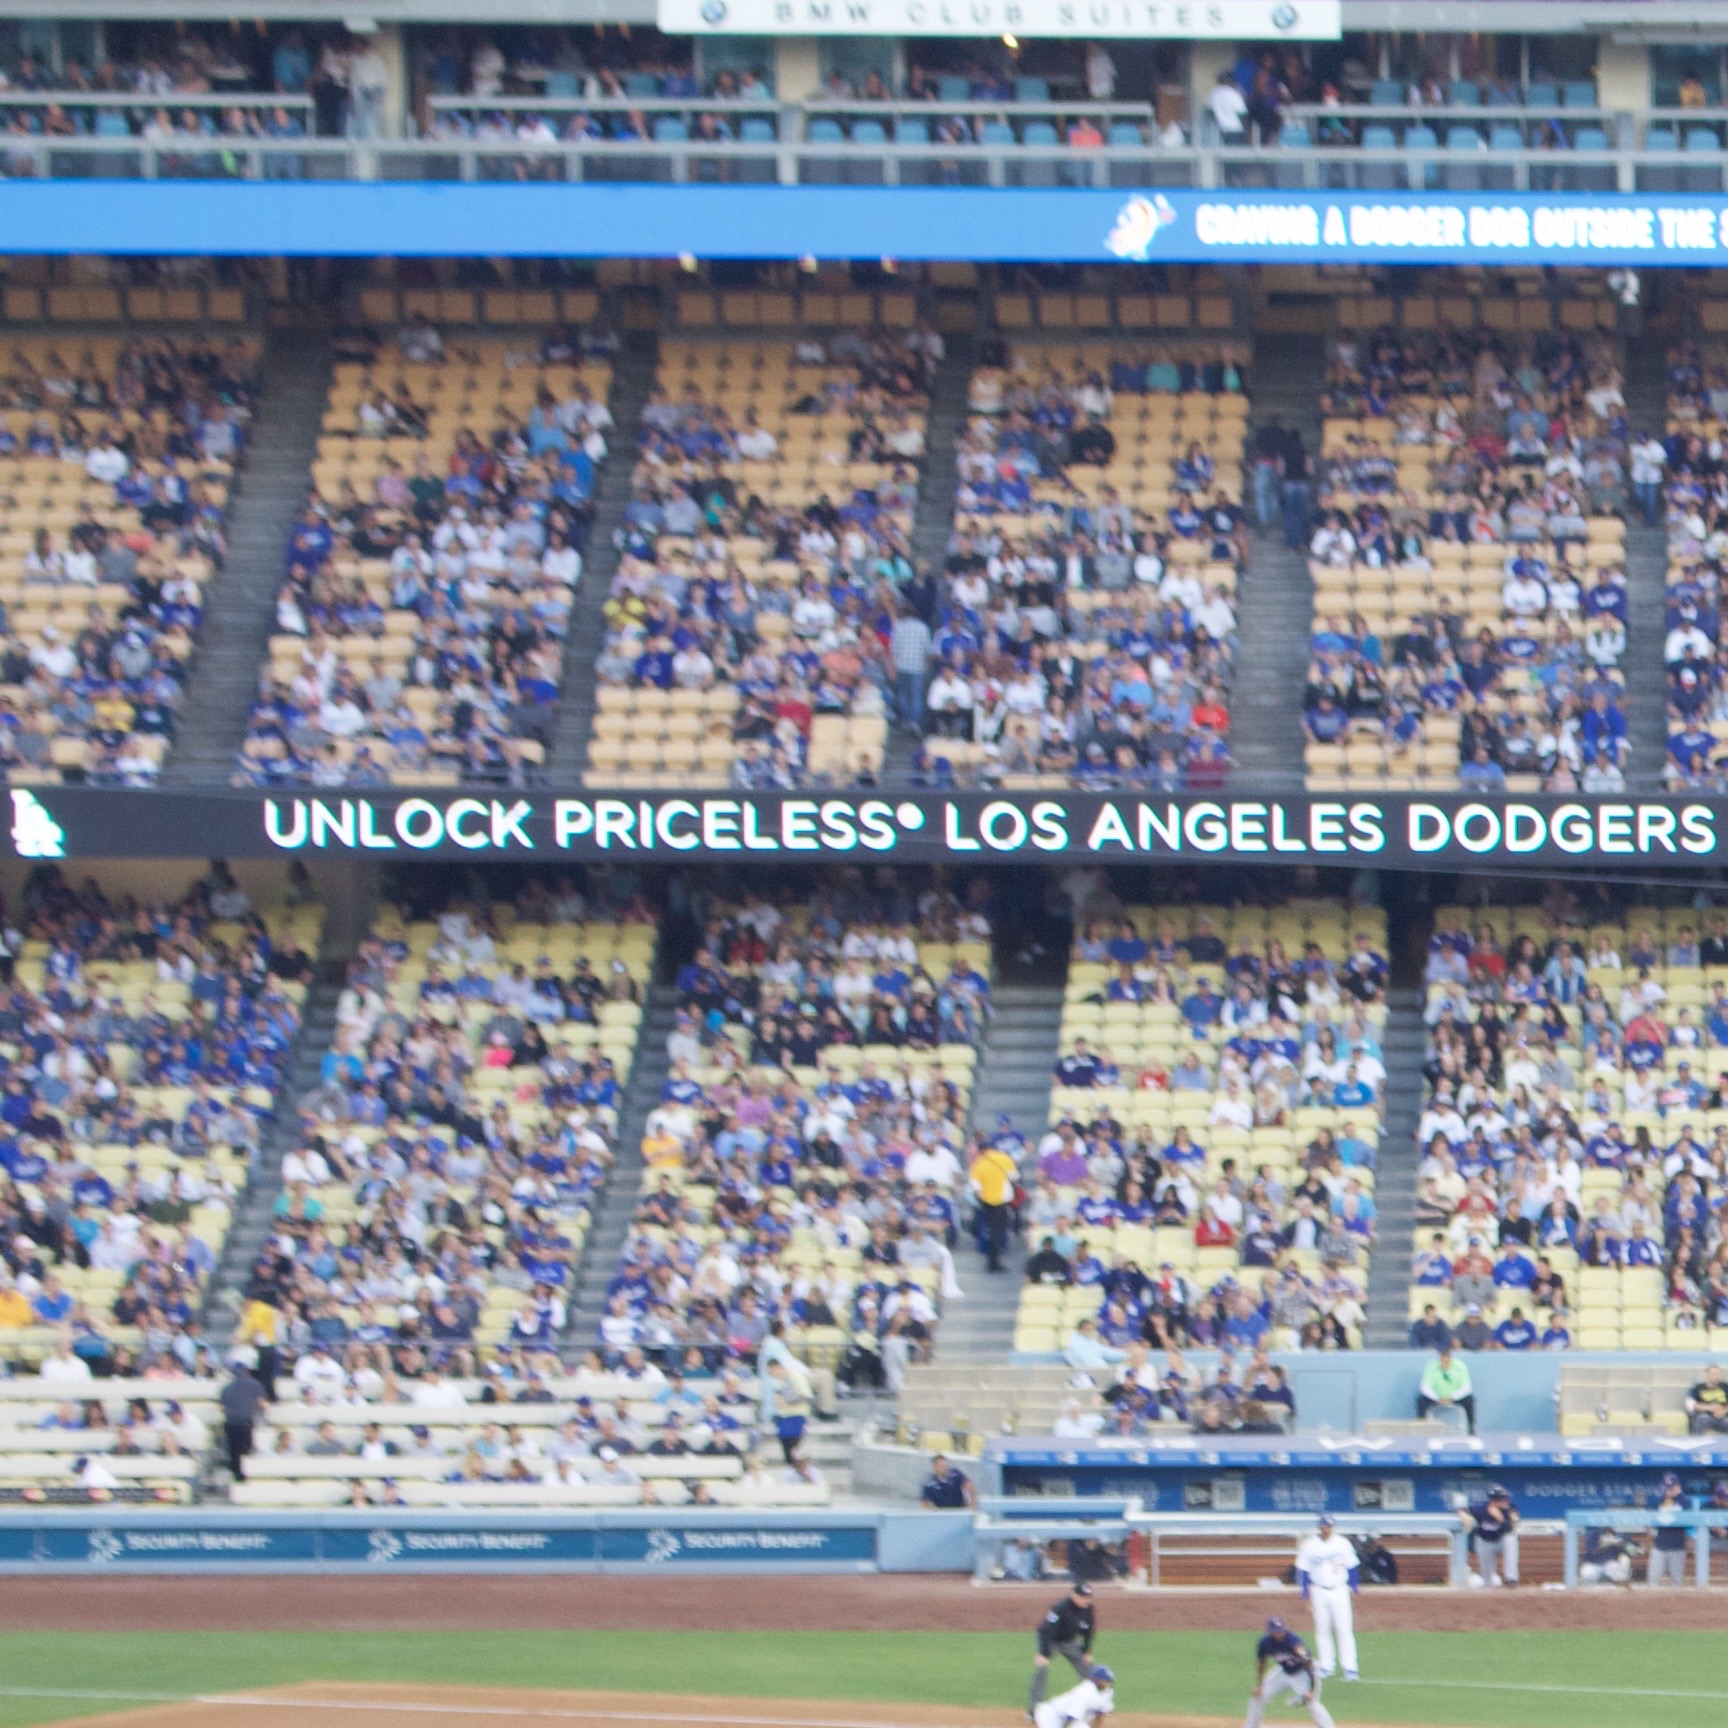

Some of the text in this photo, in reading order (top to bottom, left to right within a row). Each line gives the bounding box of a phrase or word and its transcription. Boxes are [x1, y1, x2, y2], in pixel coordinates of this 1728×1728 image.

[774, 2, 1224, 29] BMW CLUB SUITES
[1196, 204, 1318, 243] CRAVING
[1323, 205, 1347, 244] A
[1351, 206, 1464, 247] DODGER
[1469, 207, 1529, 247] DOG
[1533, 207, 1655, 248] OUTSIDE
[1659, 207, 1715, 249] THE
[264, 798, 532, 848] UNLOCK
[945, 801, 1068, 850] LOS
[1087, 802, 1385, 852] ANGELES
[1408, 803, 1716, 853] DODGERS
